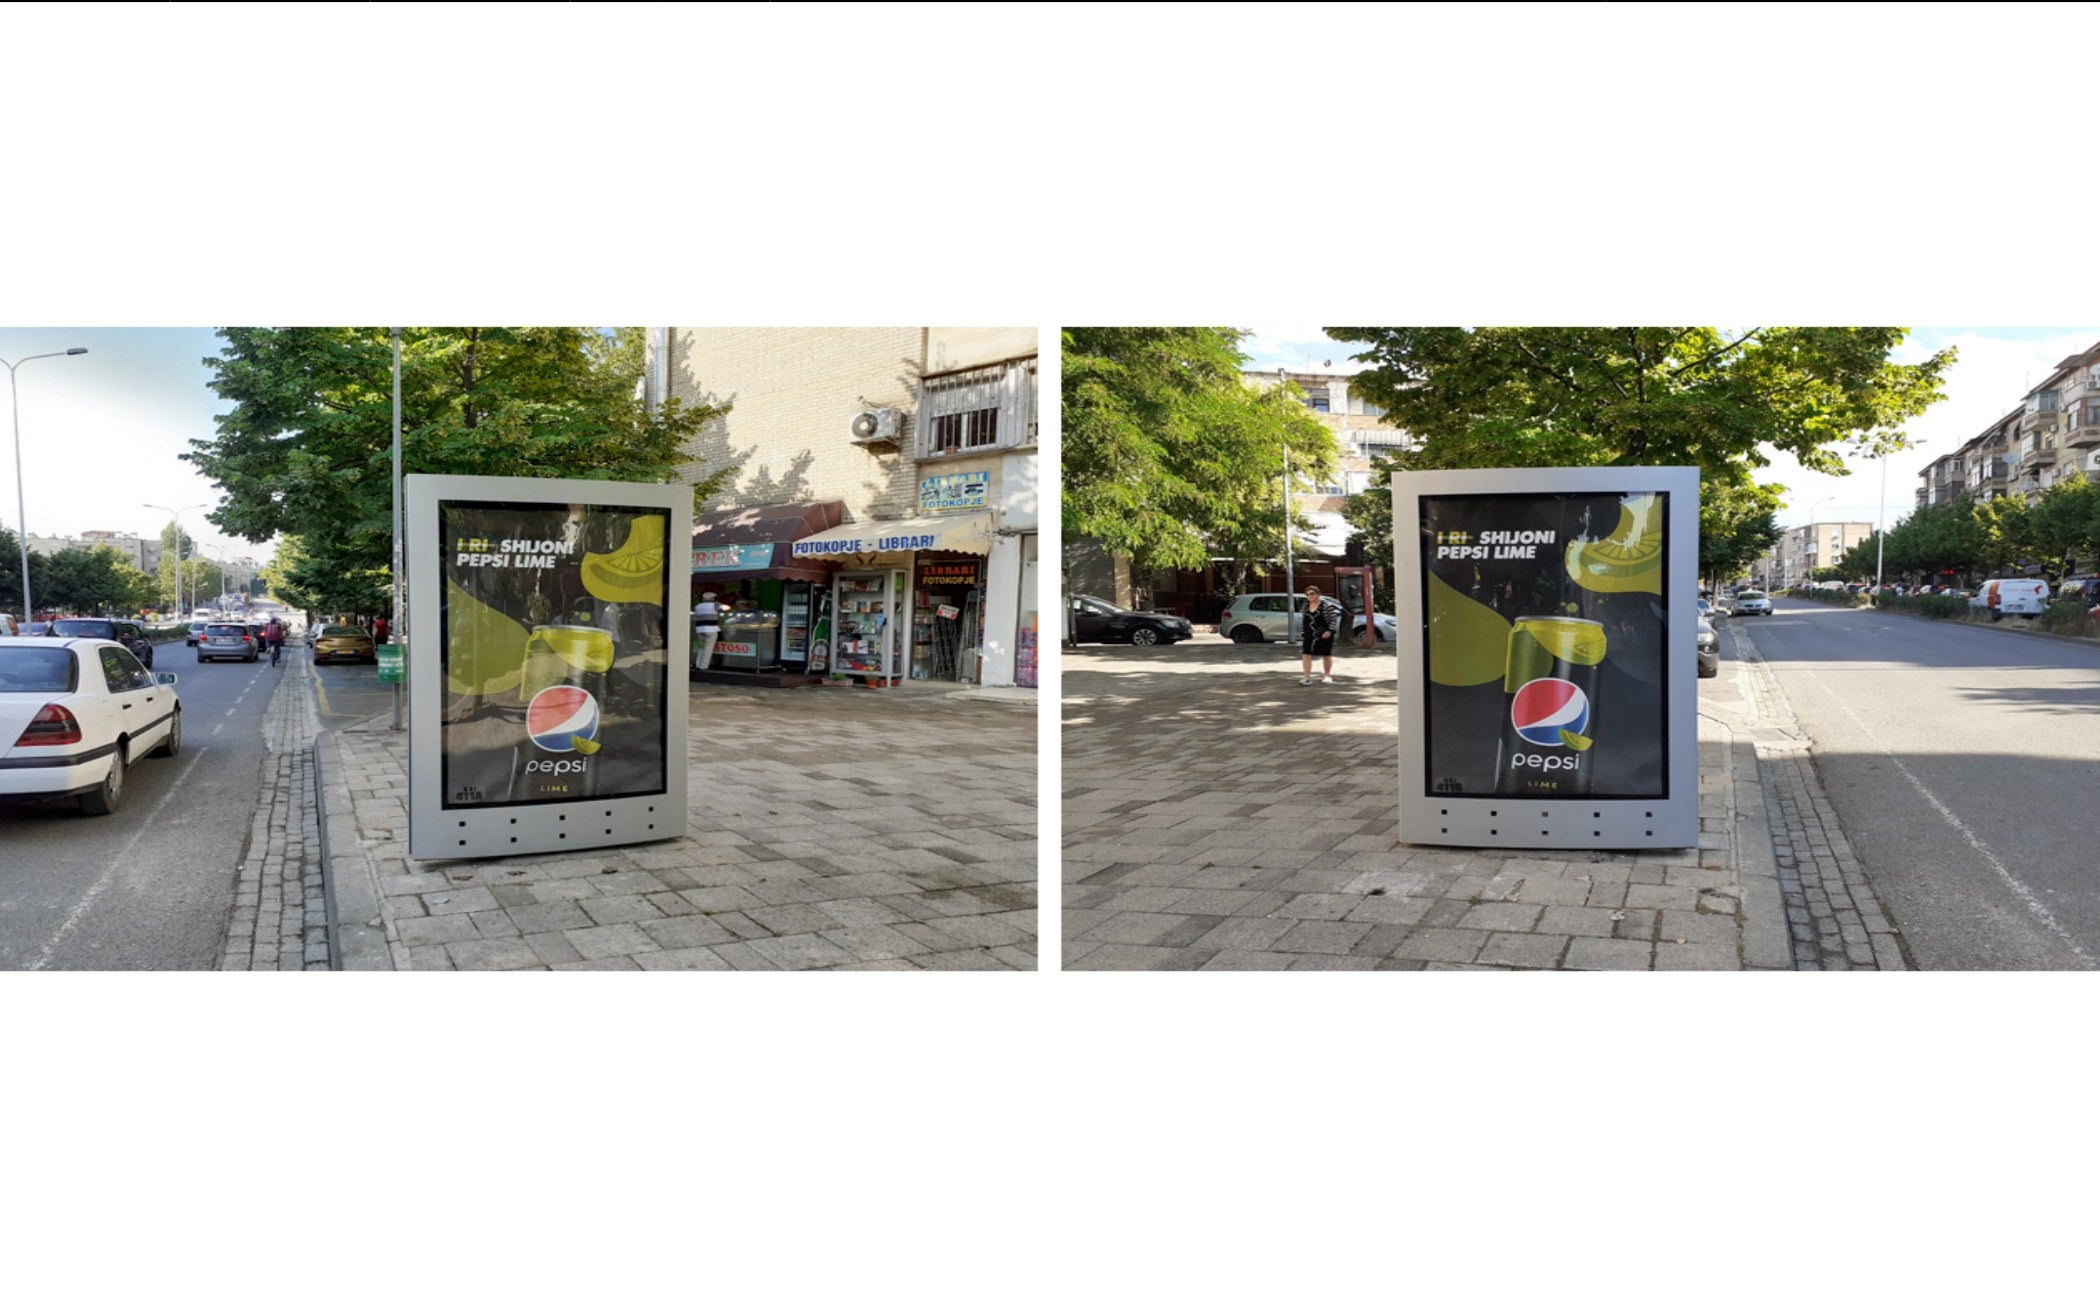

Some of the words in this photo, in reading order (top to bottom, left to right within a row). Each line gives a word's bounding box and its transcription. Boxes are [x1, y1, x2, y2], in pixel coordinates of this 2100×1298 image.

[922, 496, 984, 508] FOTOKOPJE
[1479, 530, 1556, 544] SHIJONI
[500, 539, 574, 554] SHIJONI
[793, 539, 862, 554] FOTOKOPJE
[879, 535, 935, 550] LIBRARI
[693, 550, 741, 567] REK
[1437, 546, 1489, 559] PEPSI
[1494, 546, 1537, 559] LIME
[456, 553, 509, 568] PEPSI
[514, 554, 556, 568] LIME
[923, 566, 976, 575] LIBRARI
[922, 576, 976, 585] FOTOKOPJE
[714, 641, 749, 653] STOSO
[525, 756, 587, 777] pepsi
[1510, 752, 1580, 773] pepsi
[540, 784, 569, 793] LIME
[1528, 780, 1558, 789] LIME
